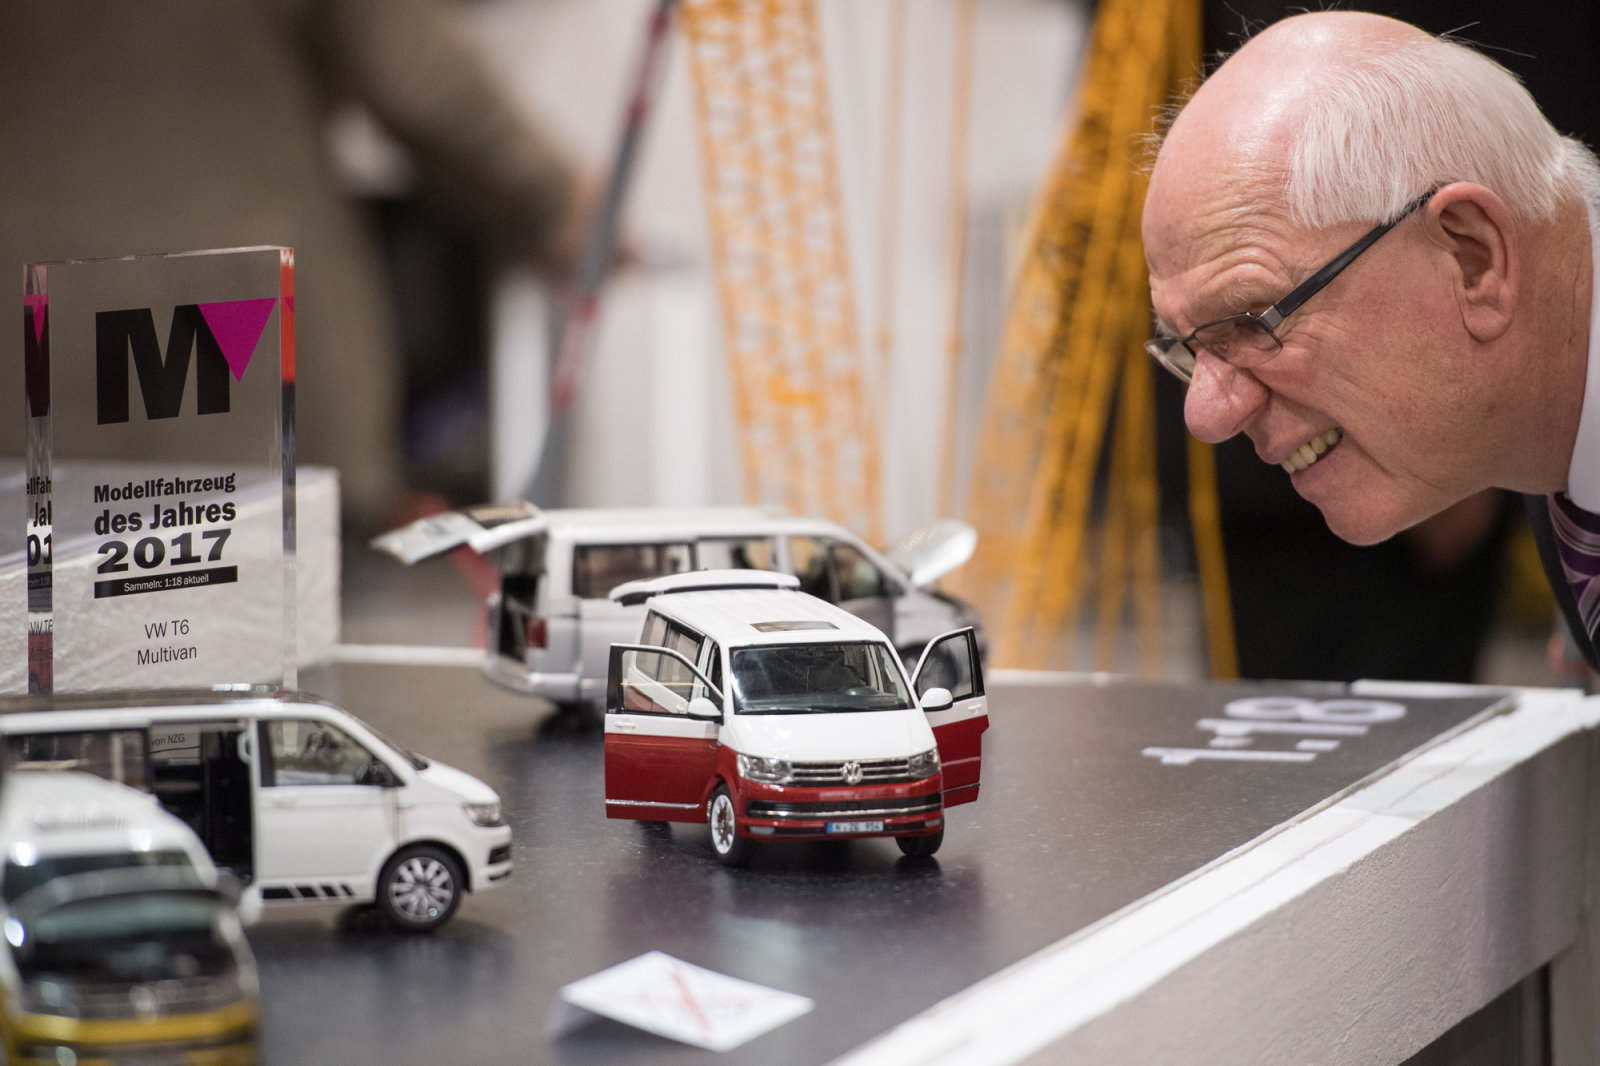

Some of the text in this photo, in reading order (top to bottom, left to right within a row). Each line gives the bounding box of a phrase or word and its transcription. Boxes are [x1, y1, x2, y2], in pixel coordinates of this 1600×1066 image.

[95, 303, 230, 425] M
[94, 473, 236, 503] Modellfahrzeug
[94, 501, 236, 535] des Jahres
[97, 528, 232, 574] 2017
[124, 574, 209, 592] Sammeln: 1:18 aktuell
[145, 619, 190, 639] VW T6
[137, 645, 198, 665] Multivan
[167, 733, 186, 745] NZG
